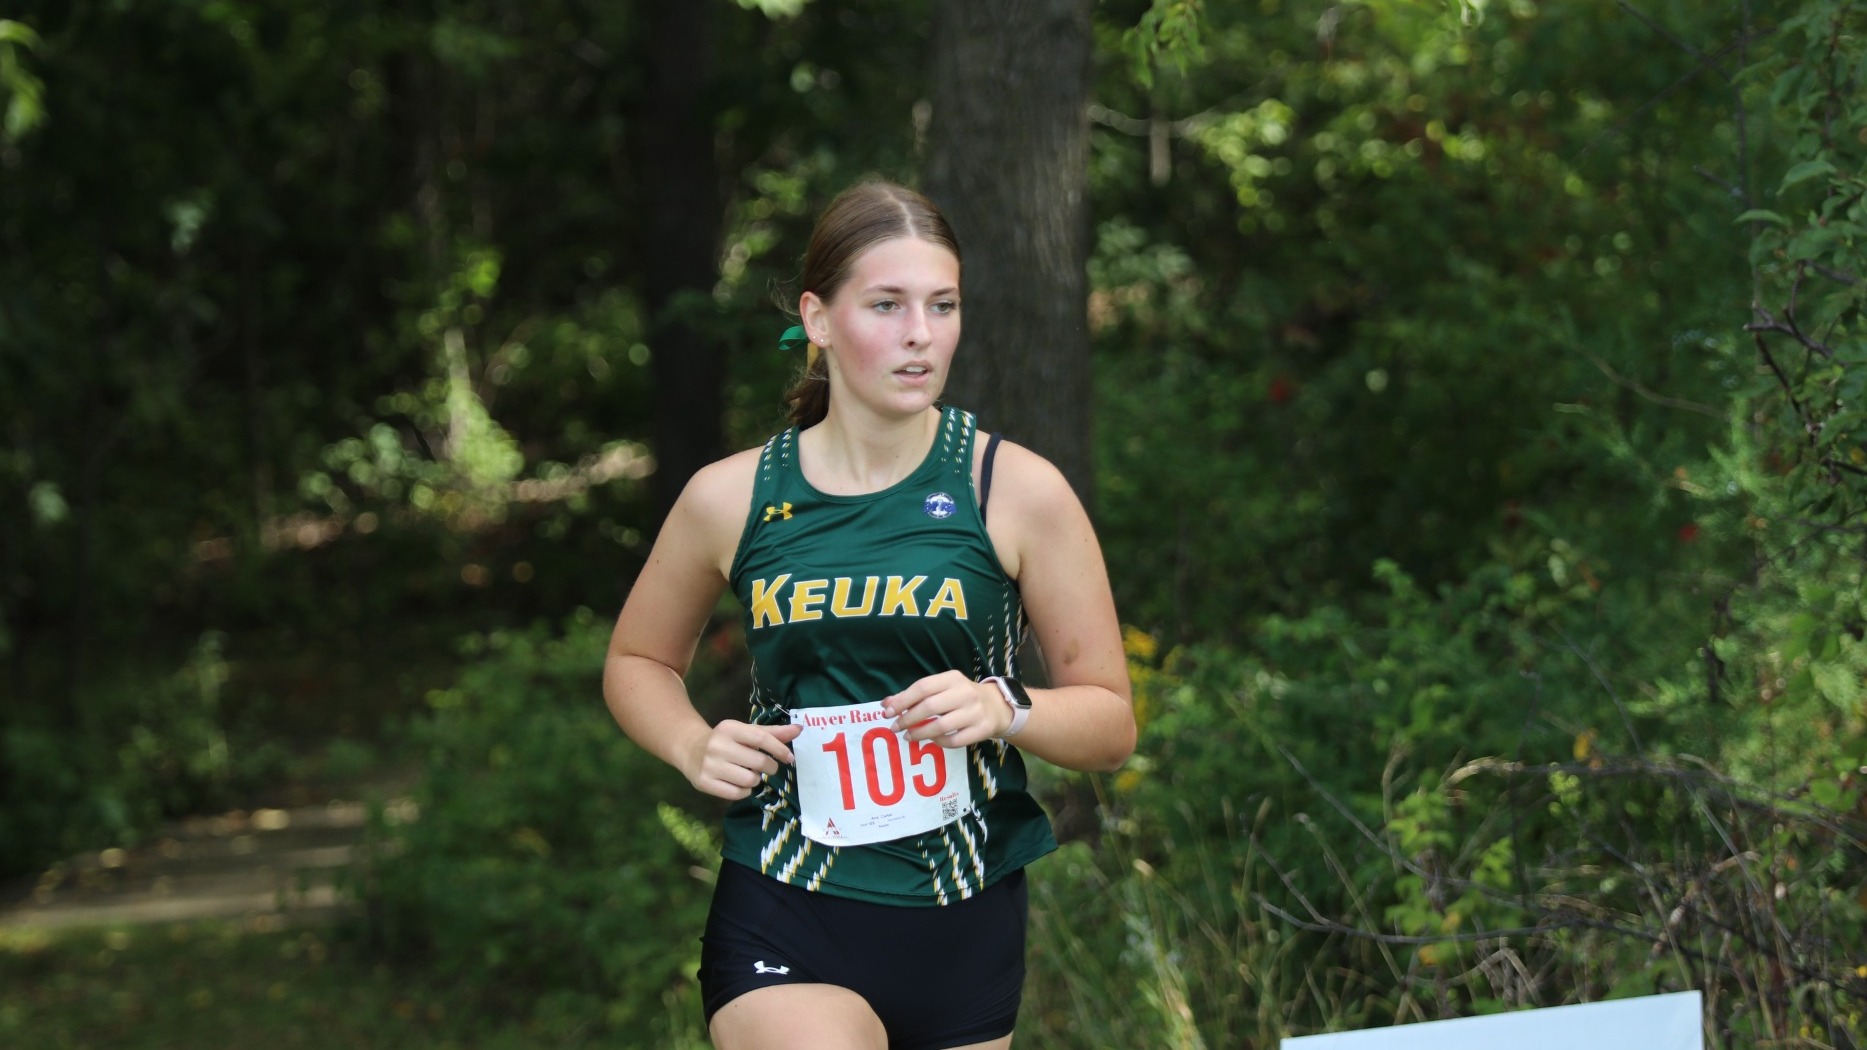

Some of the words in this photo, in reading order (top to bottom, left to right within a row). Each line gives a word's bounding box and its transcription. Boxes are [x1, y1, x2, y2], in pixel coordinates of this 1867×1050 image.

[751, 573, 968, 630] KEUKA
[803, 713, 846, 730] Auyer
[822, 717, 947, 811] 105
